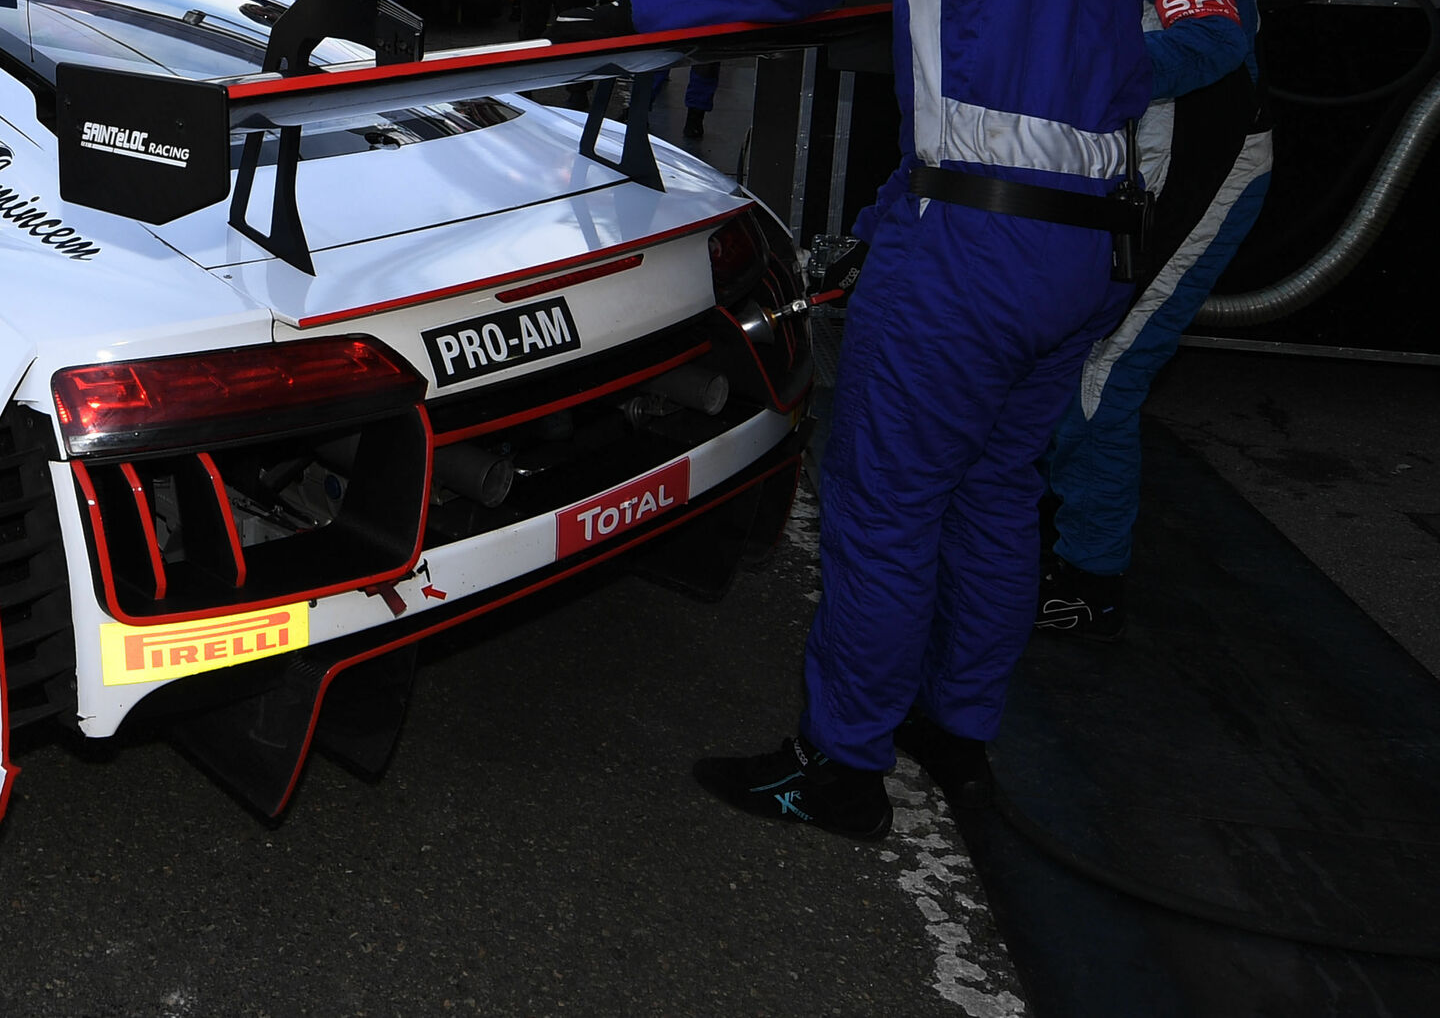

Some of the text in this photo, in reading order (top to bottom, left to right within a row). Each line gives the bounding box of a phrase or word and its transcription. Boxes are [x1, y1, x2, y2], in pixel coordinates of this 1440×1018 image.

[148, 142, 190, 160] RACING
[436, 306, 572, 377] PRO-AM
[576, 484, 675, 542] TOTAL
[123, 611, 291, 672] PIRELLI
